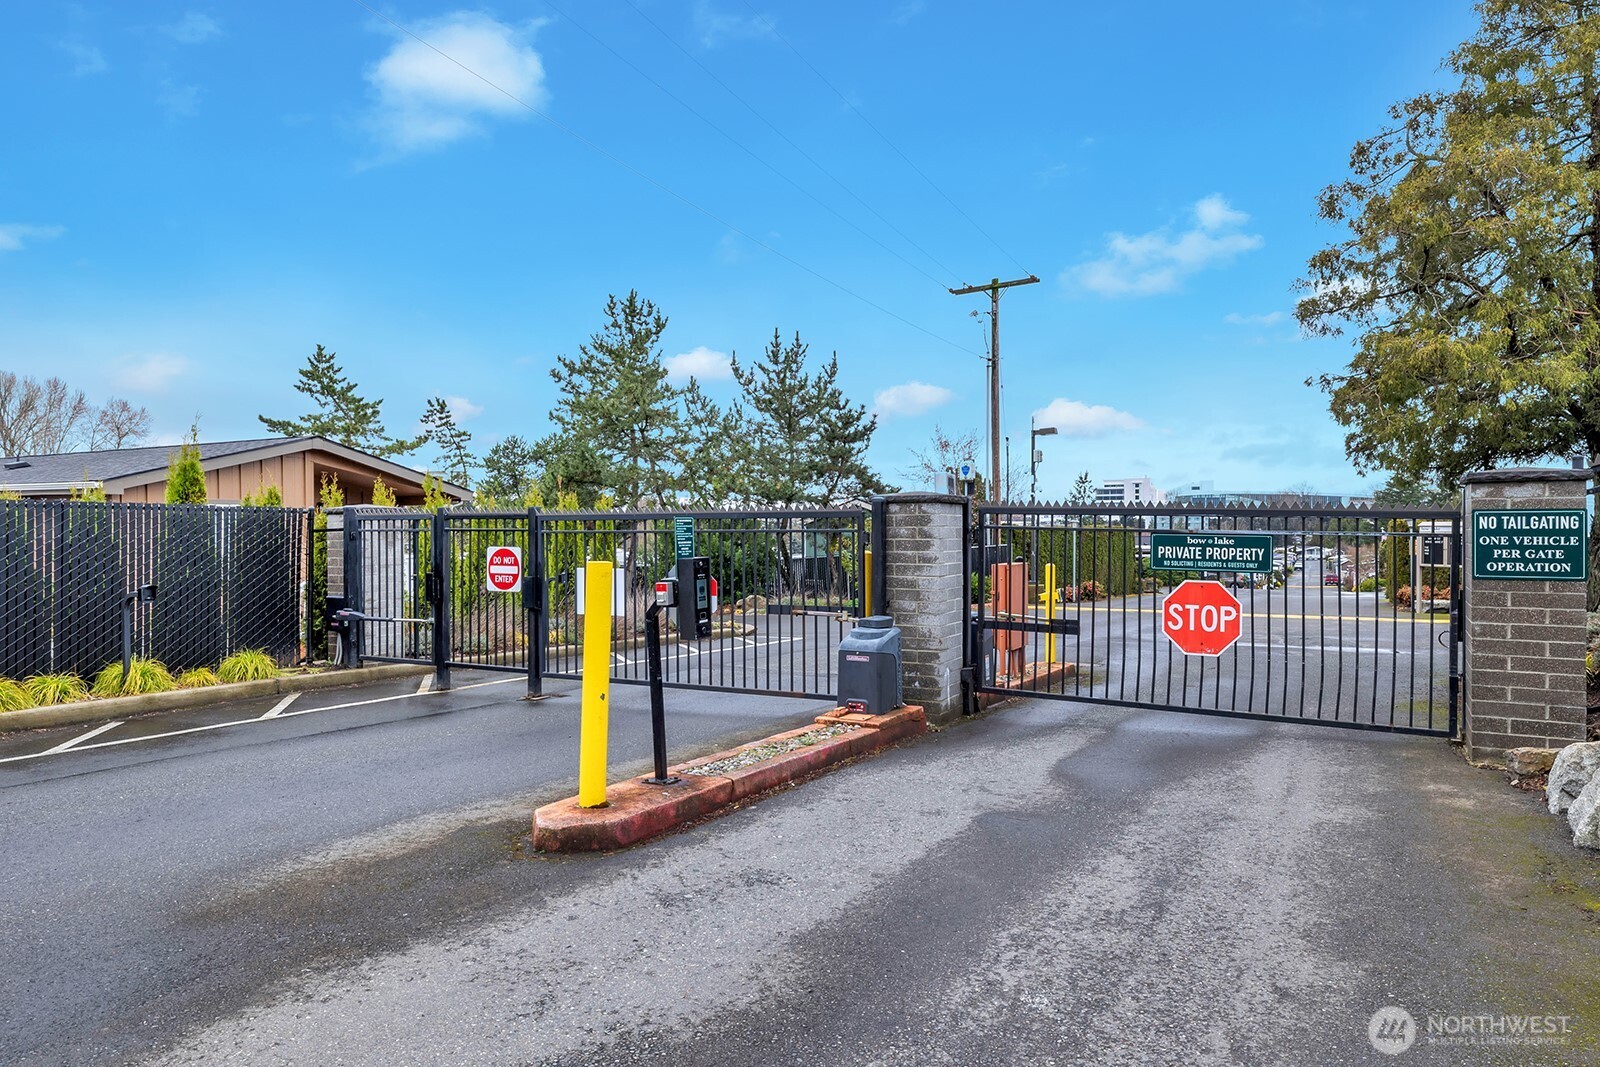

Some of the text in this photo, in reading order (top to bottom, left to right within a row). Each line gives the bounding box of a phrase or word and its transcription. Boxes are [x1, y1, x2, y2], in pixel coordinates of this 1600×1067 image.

[1479, 516, 1579, 529] NO TAILGATING
[1187, 536, 1235, 545] bow lake
[1479, 536, 1579, 546] ONE VEHICLE
[1158, 546, 1265, 561] PRIVATE PROPERTY
[1493, 549, 1565, 559] PER GATE
[493, 556, 515, 565] DO NOT
[1486, 562, 1571, 572] OPERATION
[494, 575, 513, 583] ENTER
[1167, 603, 1237, 633] STOP
